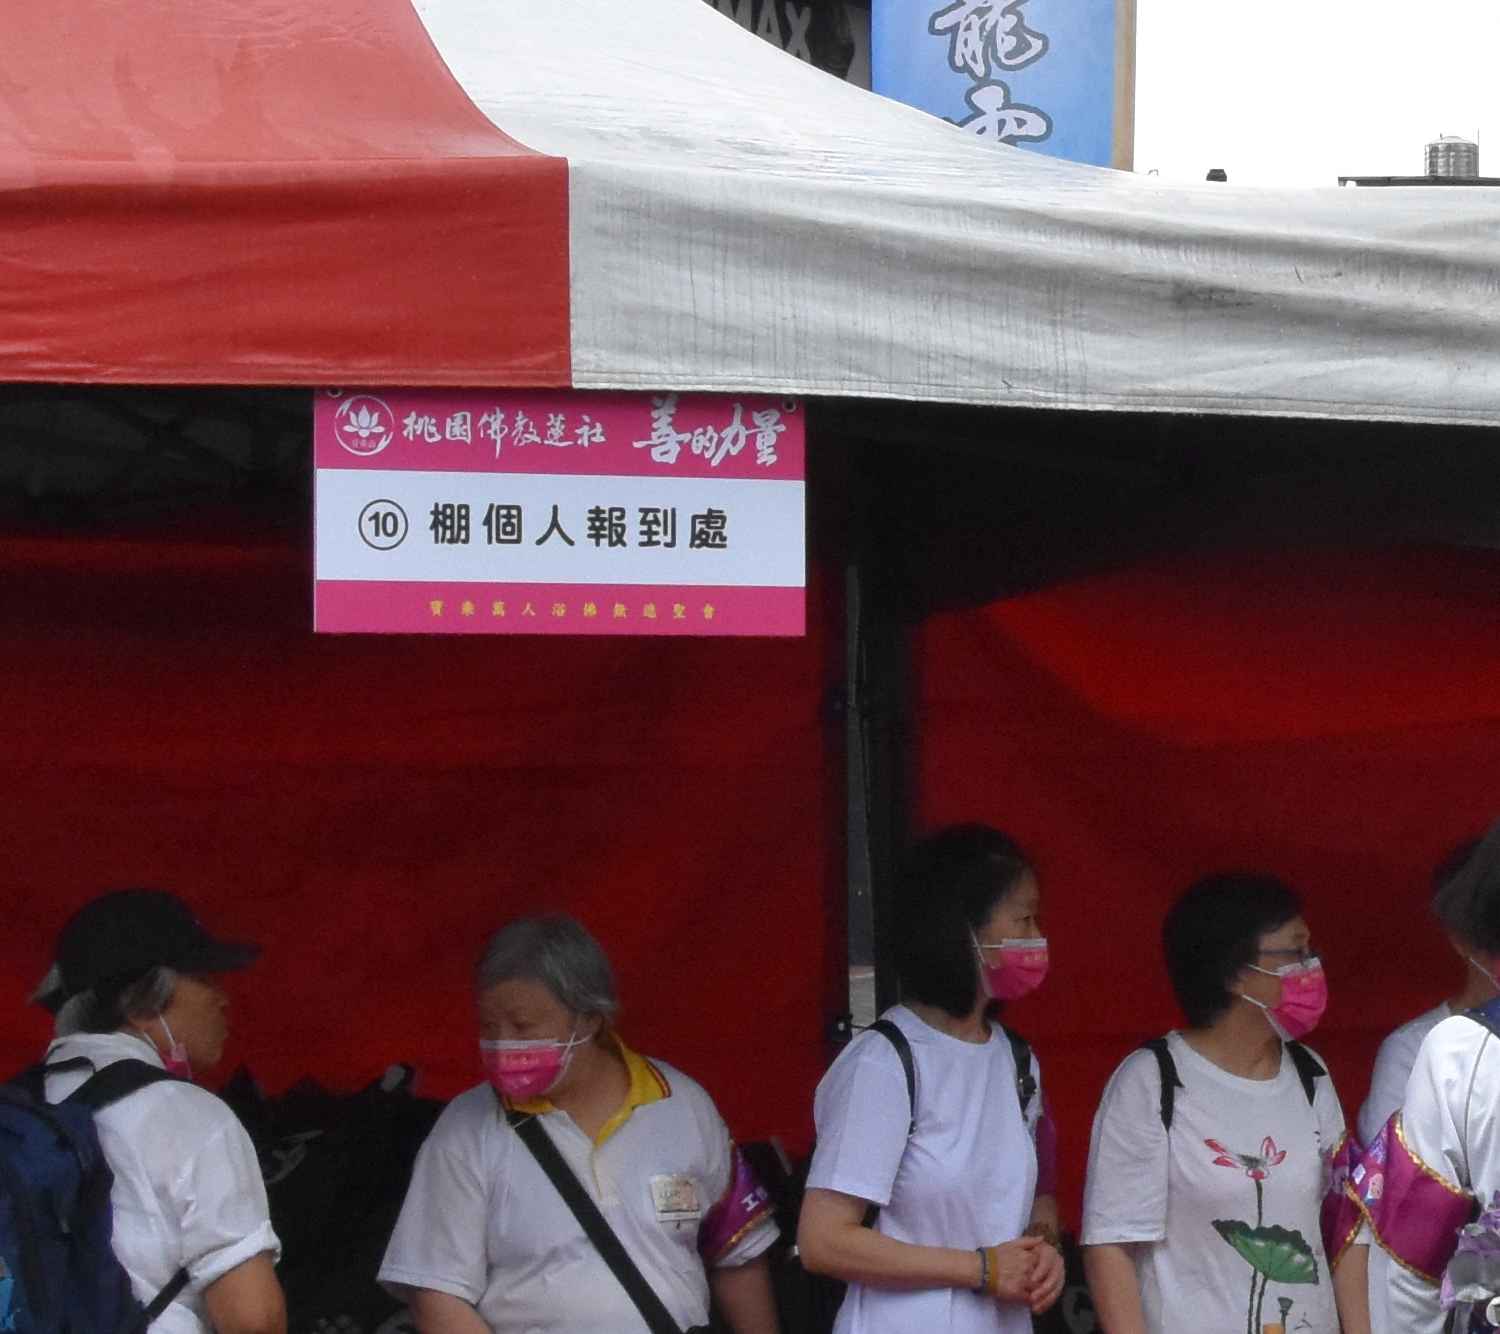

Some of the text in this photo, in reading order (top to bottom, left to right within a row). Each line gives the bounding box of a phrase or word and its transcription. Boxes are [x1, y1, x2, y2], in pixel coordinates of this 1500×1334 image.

[402, 394, 786, 467] 桃園佛教蓮社 善的力量
[429, 502, 729, 550] 棚個人報到處
